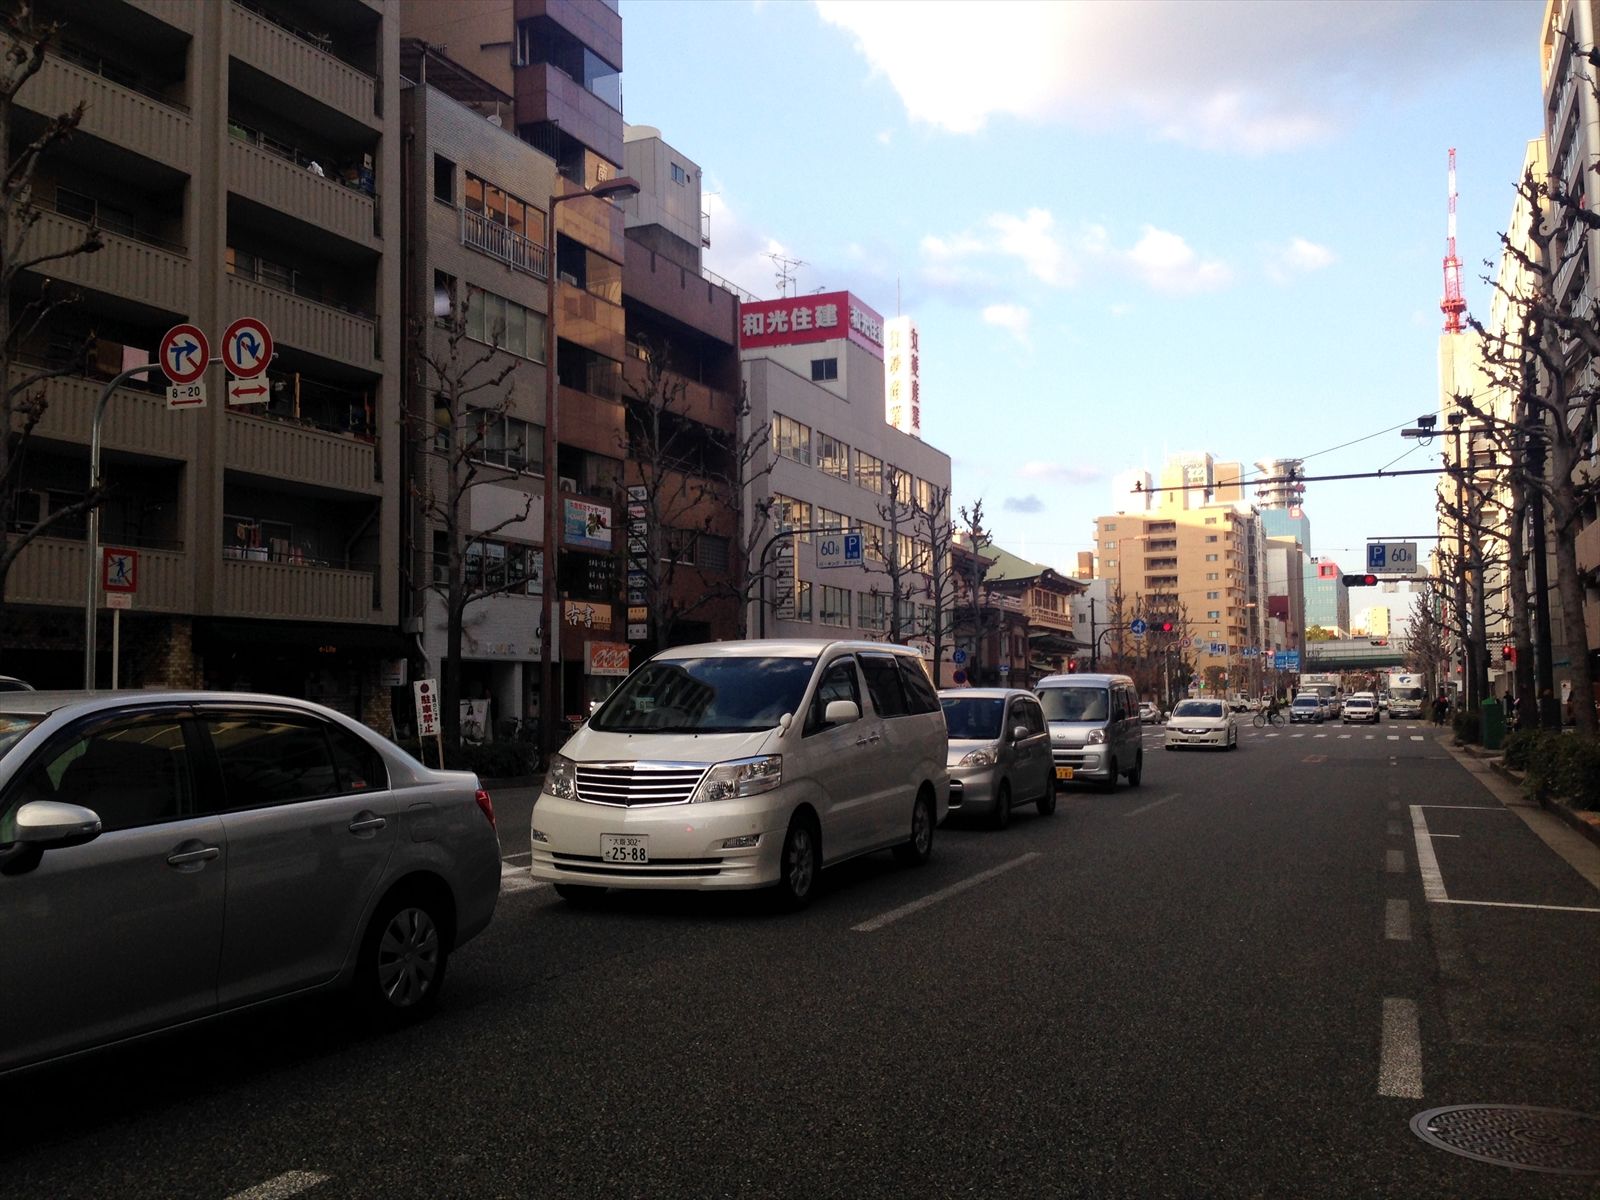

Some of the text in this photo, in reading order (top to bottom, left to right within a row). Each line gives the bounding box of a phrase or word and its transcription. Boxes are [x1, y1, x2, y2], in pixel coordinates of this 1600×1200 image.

[742, 304, 838, 336] 和光住建
[421, 694, 433, 733] 駐車禁止
[612, 847, 646, 861] 25-88
